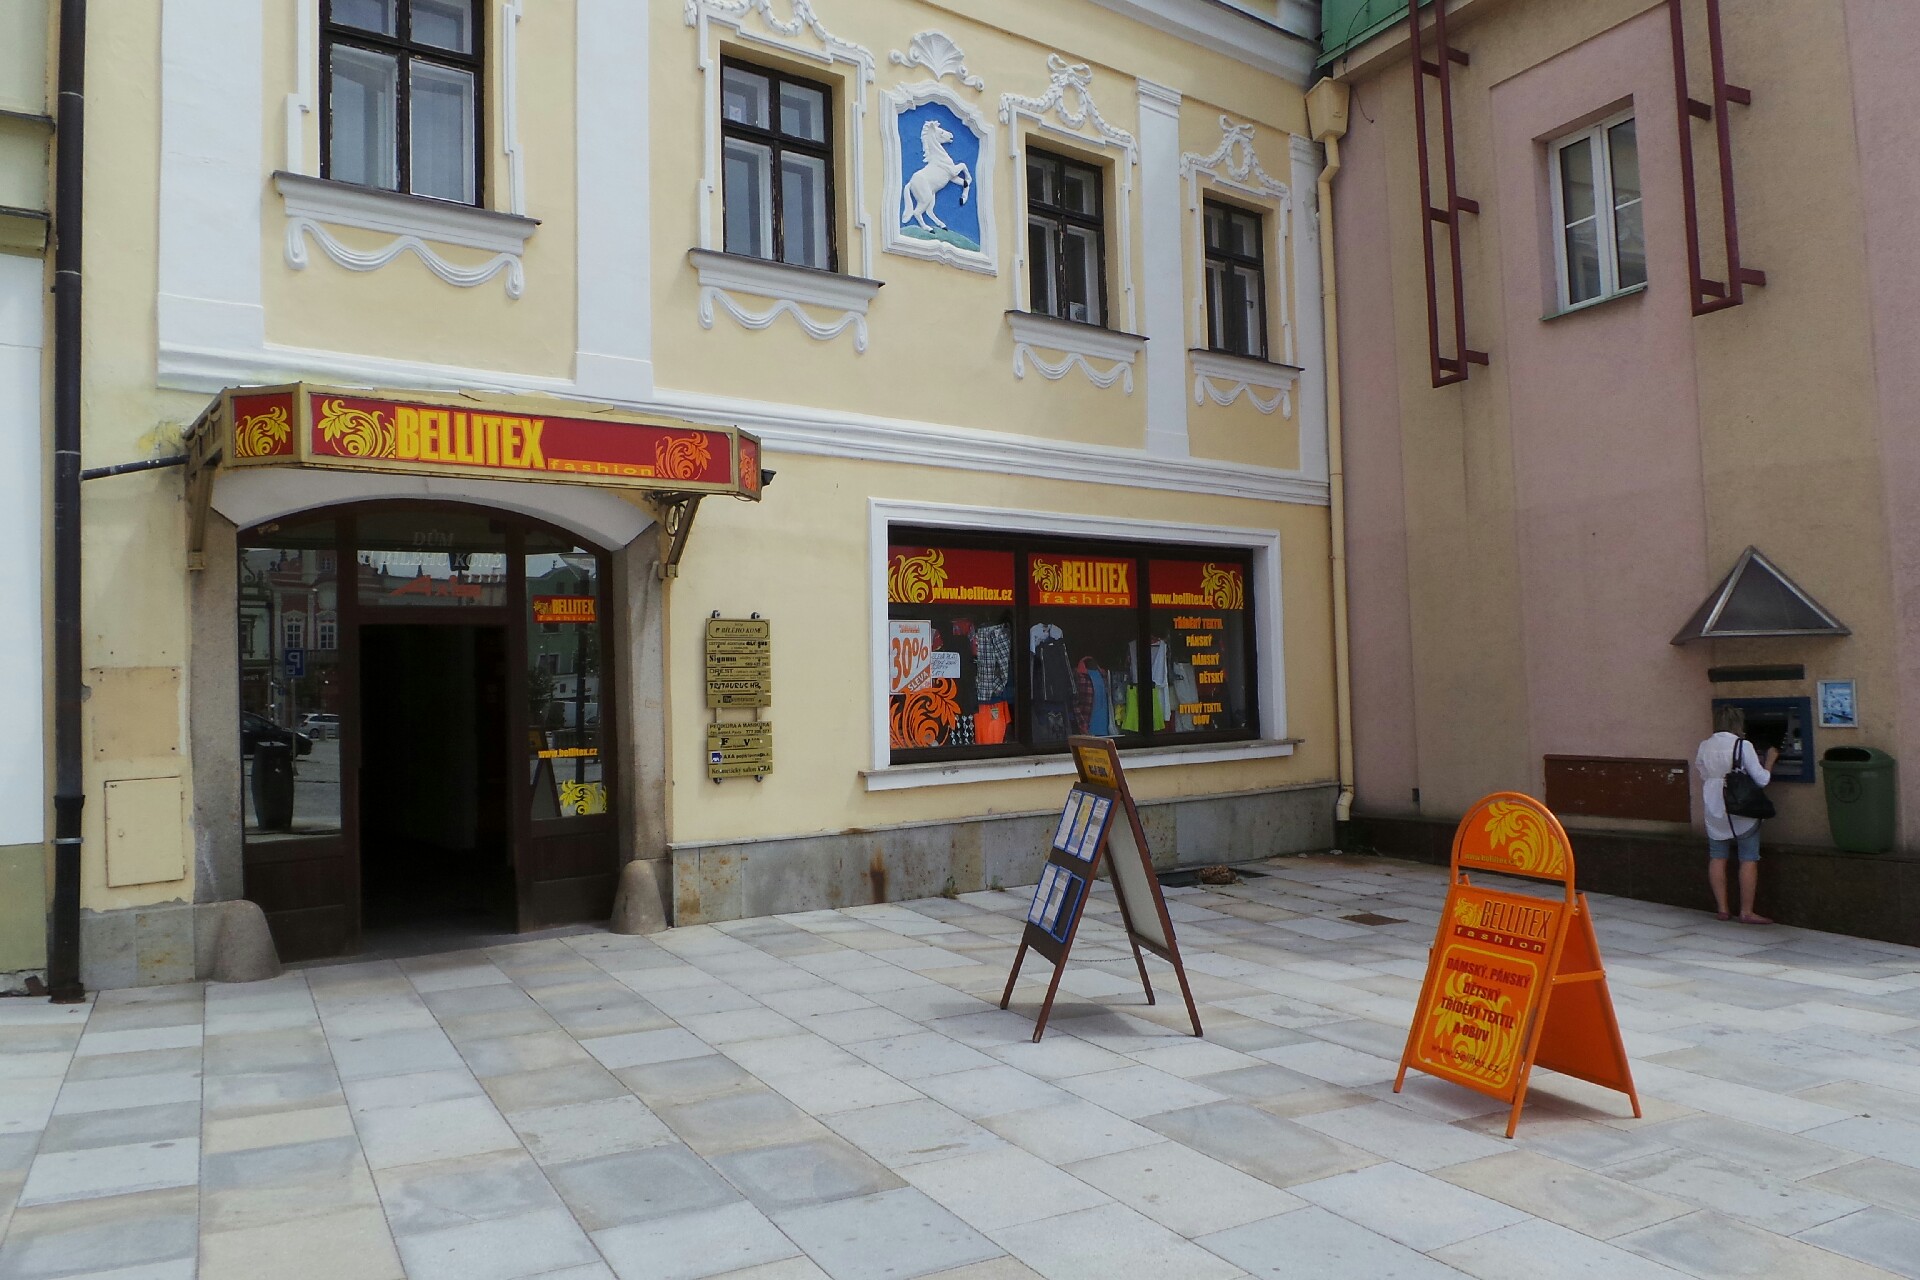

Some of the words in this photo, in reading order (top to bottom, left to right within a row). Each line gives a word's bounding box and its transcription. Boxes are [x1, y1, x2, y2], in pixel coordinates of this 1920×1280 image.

[395, 406, 546, 470] BELLITEX
[550, 459, 654, 477] fashion
[412, 529, 455, 547] DŮM
[1062, 560, 1129, 594] BELLITEX
[932, 586, 1013, 601] www.bellitex.cz
[1042, 592, 1129, 605] fashion
[1151, 592, 1214, 606] www.bellitex.cz
[552, 599, 595, 614] BELLITEX
[1201, 618, 1224, 630] TEXTIL
[1186, 633, 1213, 647] PÁNSKÝ
[892, 637, 929, 691] 30%
[1192, 652, 1220, 666] DÁMSKÝ
[908, 670, 929, 692] SLEVA
[1199, 671, 1225, 684] DĚTSKÝ
[1203, 702, 1223, 713] TEXTIL
[538, 748, 598, 759] www.bellitex.cz
[1480, 900, 1552, 939] BELLITEX
[1457, 927, 1542, 952] fashion
[1489, 967, 1530, 988] PÁNSKÝ
[1463, 981, 1501, 1003] DĚTSKÝ
[1441, 995, 1481, 1019] TŘÍDĚNÝ
[1482, 1008, 1515, 1029] TEXTIL
[1452, 1021, 1461, 1034] A
[1462, 1024, 1490, 1042] OBUV
[1431, 1044, 1499, 1074] www.bellitex.cz
